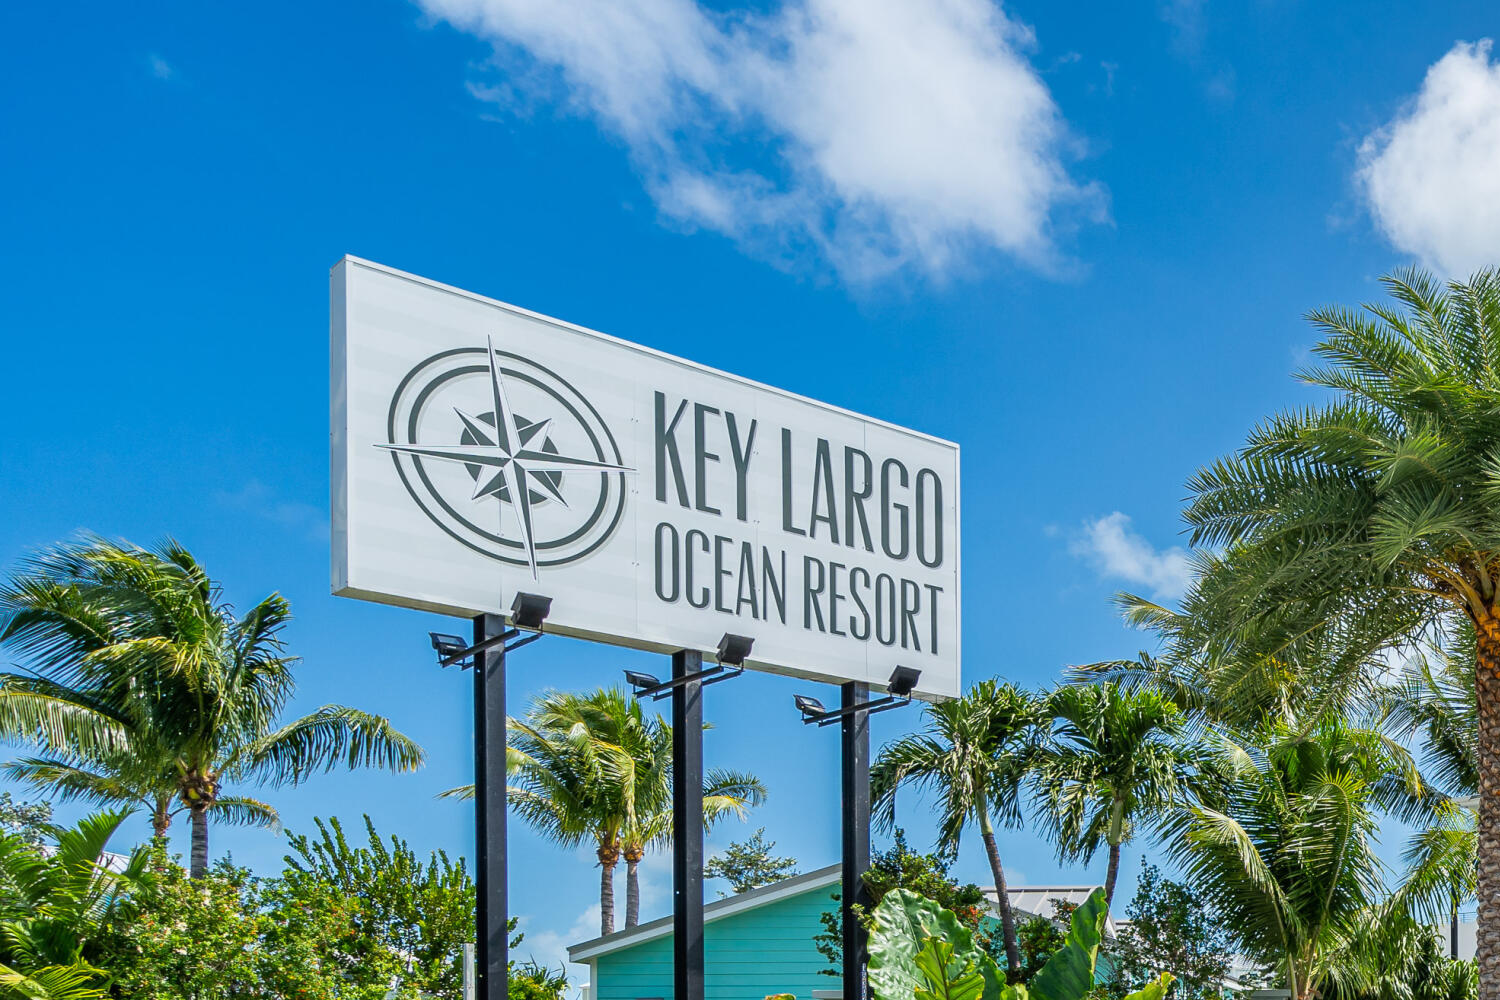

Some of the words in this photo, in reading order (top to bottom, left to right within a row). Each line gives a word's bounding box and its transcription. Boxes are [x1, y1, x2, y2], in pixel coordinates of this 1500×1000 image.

[654, 390, 758, 522] KEY
[781, 427, 944, 569] LARGO
[654, 521, 786, 626] OCEAN
[803, 555, 944, 656] RESORT
